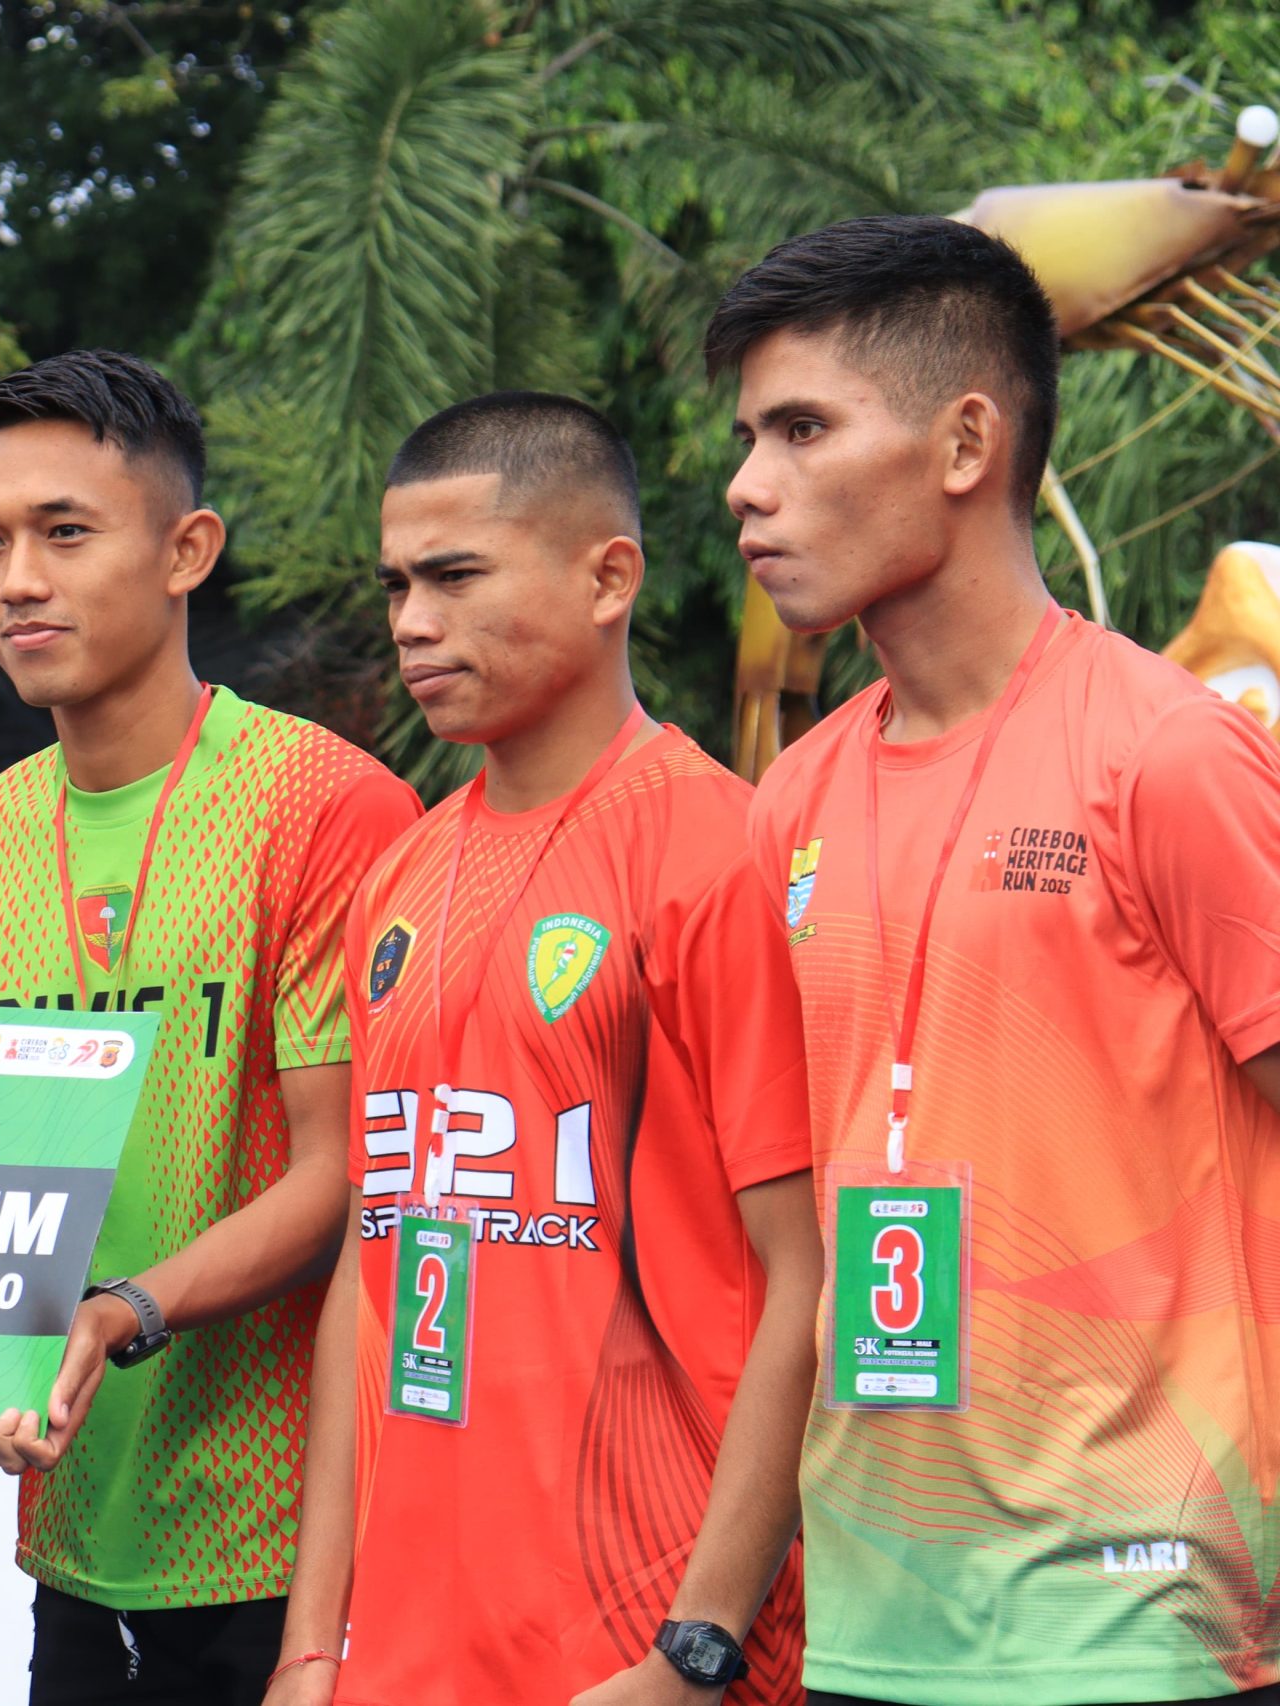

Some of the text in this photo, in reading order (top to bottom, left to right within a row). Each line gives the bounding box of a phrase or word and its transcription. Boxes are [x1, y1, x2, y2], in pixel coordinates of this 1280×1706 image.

[1010, 827, 1088, 854] CIREBON
[1007, 849, 1088, 876] HERITAGE
[1002, 870, 1072, 894] RUN 2025
[541, 916, 602, 940] INDONESIA
[201, 981, 226, 1058] 1
[467, 1210, 600, 1252] TRACK
[871, 1224, 925, 1334] 3
[412, 1253, 449, 1354] 2
[854, 1337, 881, 1356] 5K
[402, 1352, 418, 1370] 5K
[1102, 1541, 1188, 1573] LARI
